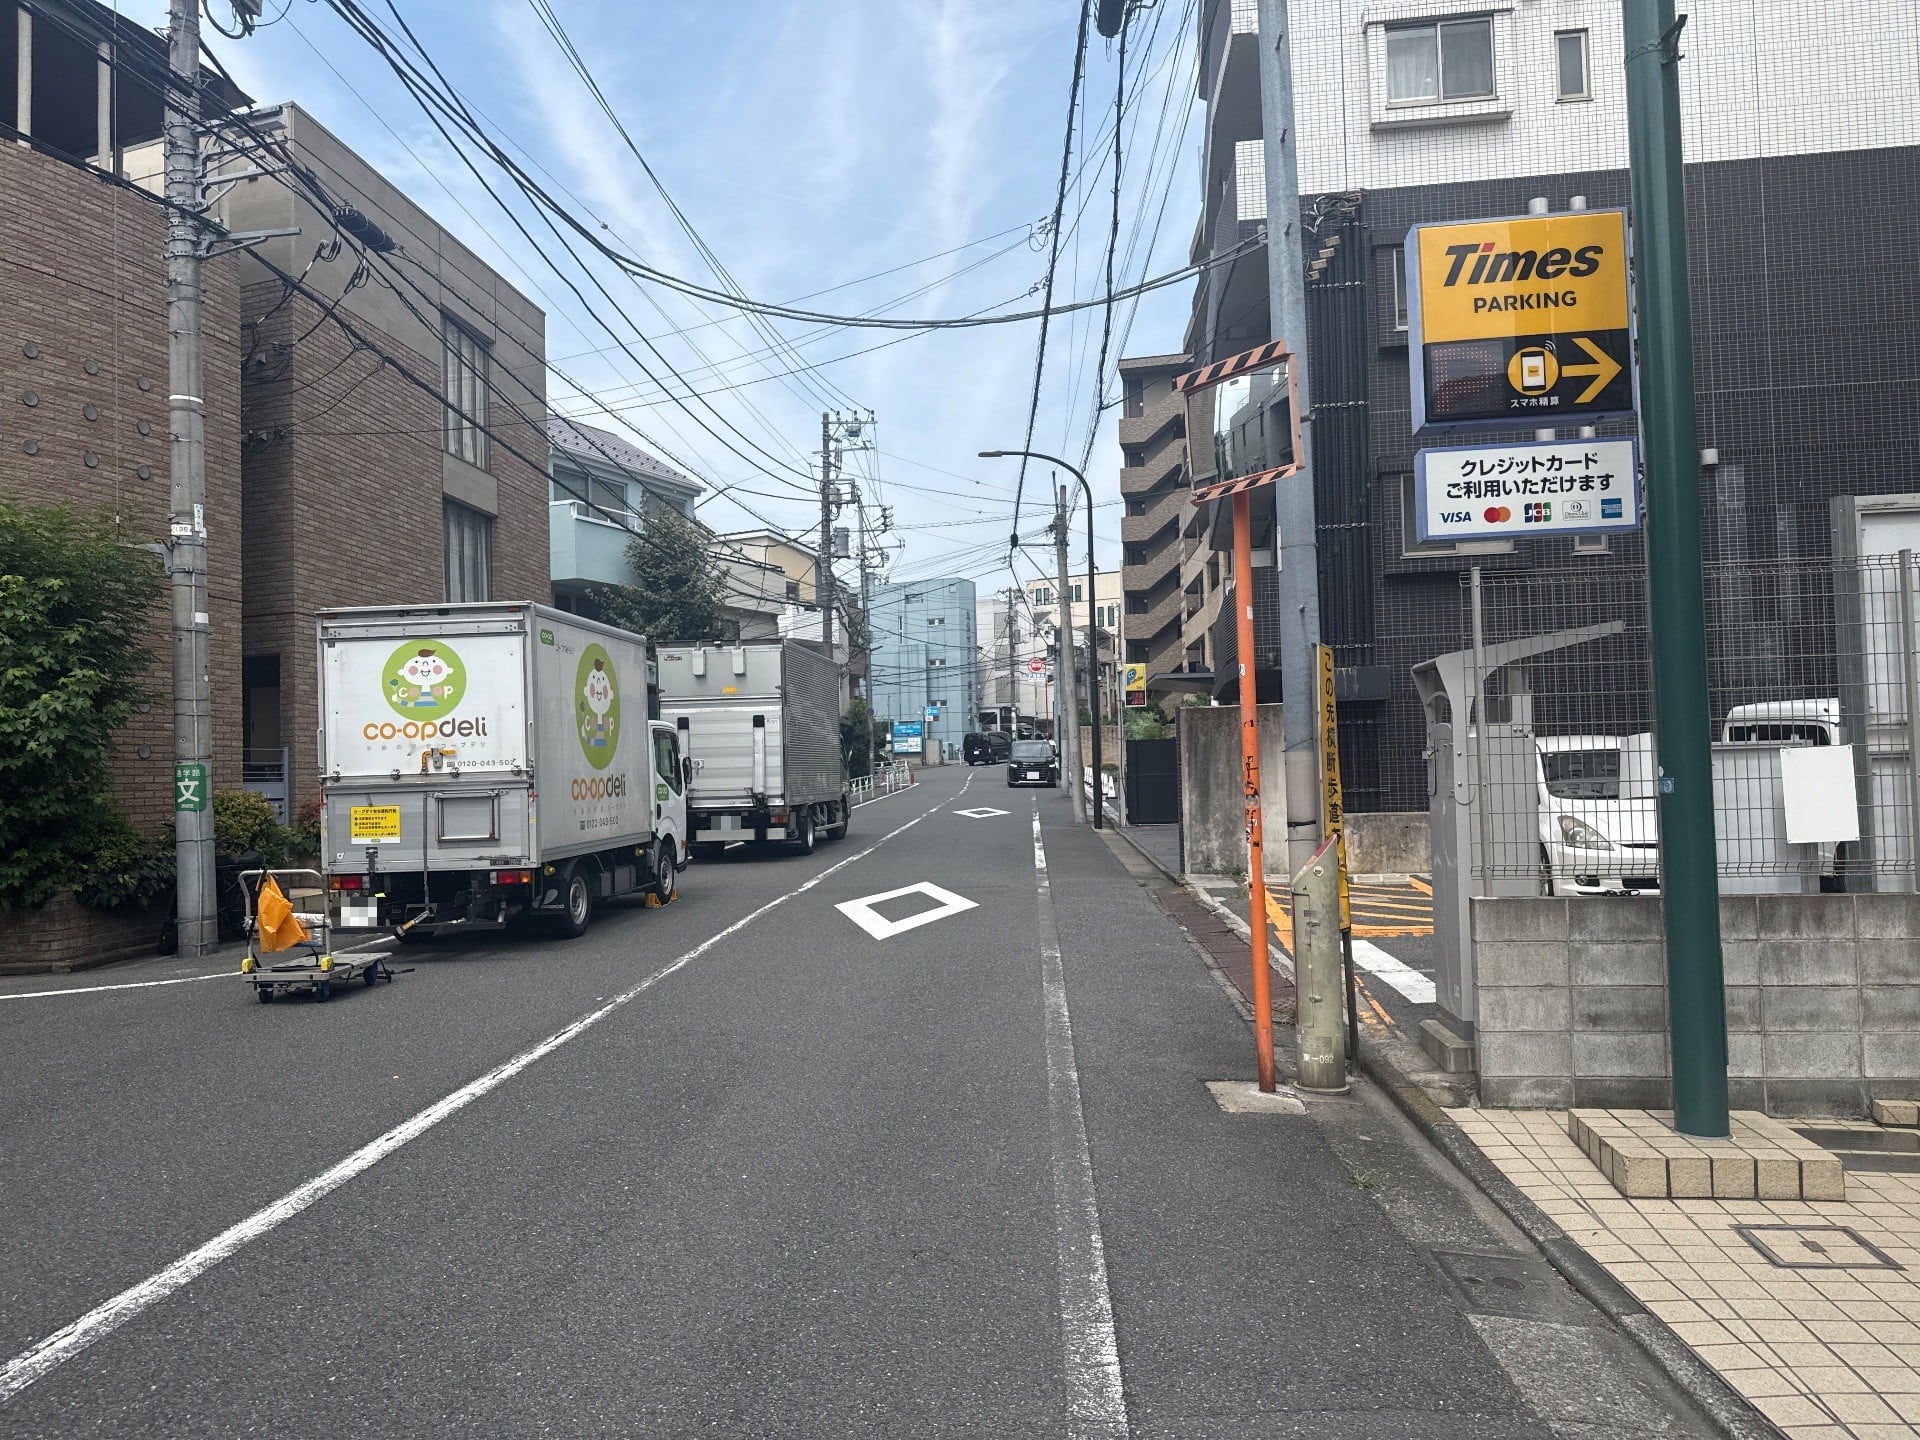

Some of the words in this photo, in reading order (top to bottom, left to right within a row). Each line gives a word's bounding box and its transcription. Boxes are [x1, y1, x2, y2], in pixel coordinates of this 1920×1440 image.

[1443, 241, 1604, 287] Times
[1474, 290, 1577, 314] PARKING
[1510, 396, 1560, 408] スマホ精算
[1460, 452, 1598, 477] クレジットカード
[1446, 473, 1615, 499] ご利用いただけます
[1440, 511, 1472, 524] VISA
[1324, 651, 1342, 870] この先横断歩道あ
[177, 778, 200, 803] 文
